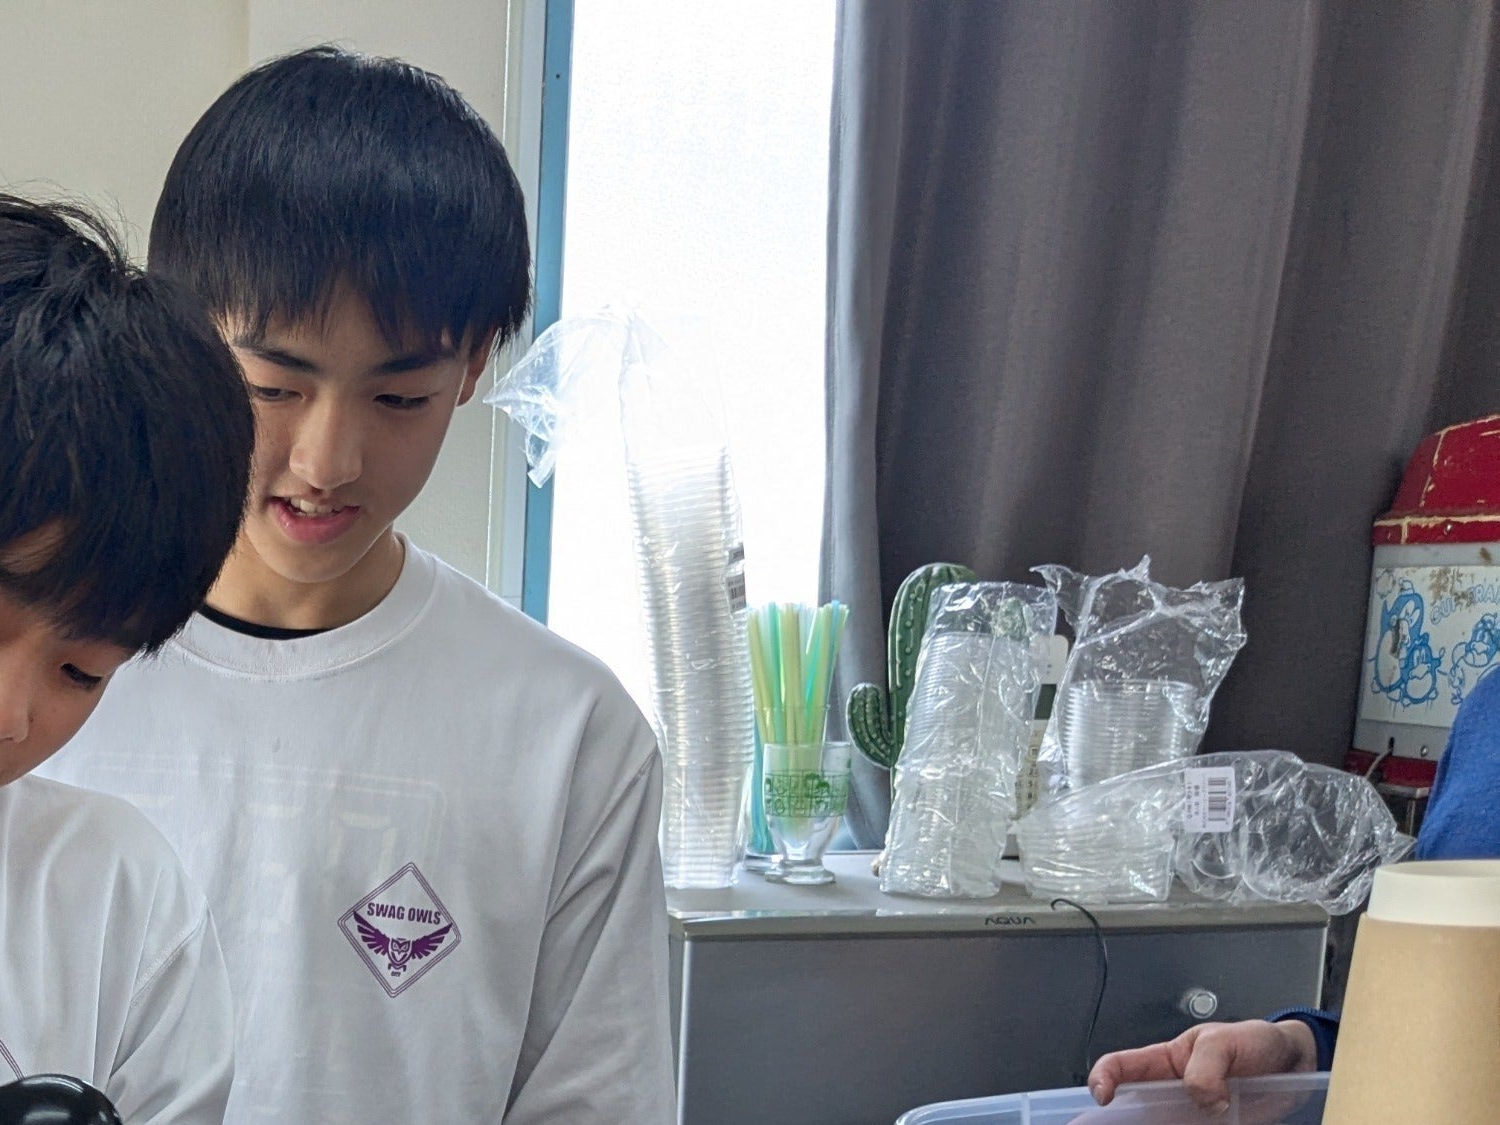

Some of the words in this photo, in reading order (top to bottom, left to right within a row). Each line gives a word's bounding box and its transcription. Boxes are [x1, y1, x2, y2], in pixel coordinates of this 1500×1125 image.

[367, 902, 405, 920] SWAG
[407, 907, 441, 925] OWLS
[984, 916, 1037, 926] AQUA
